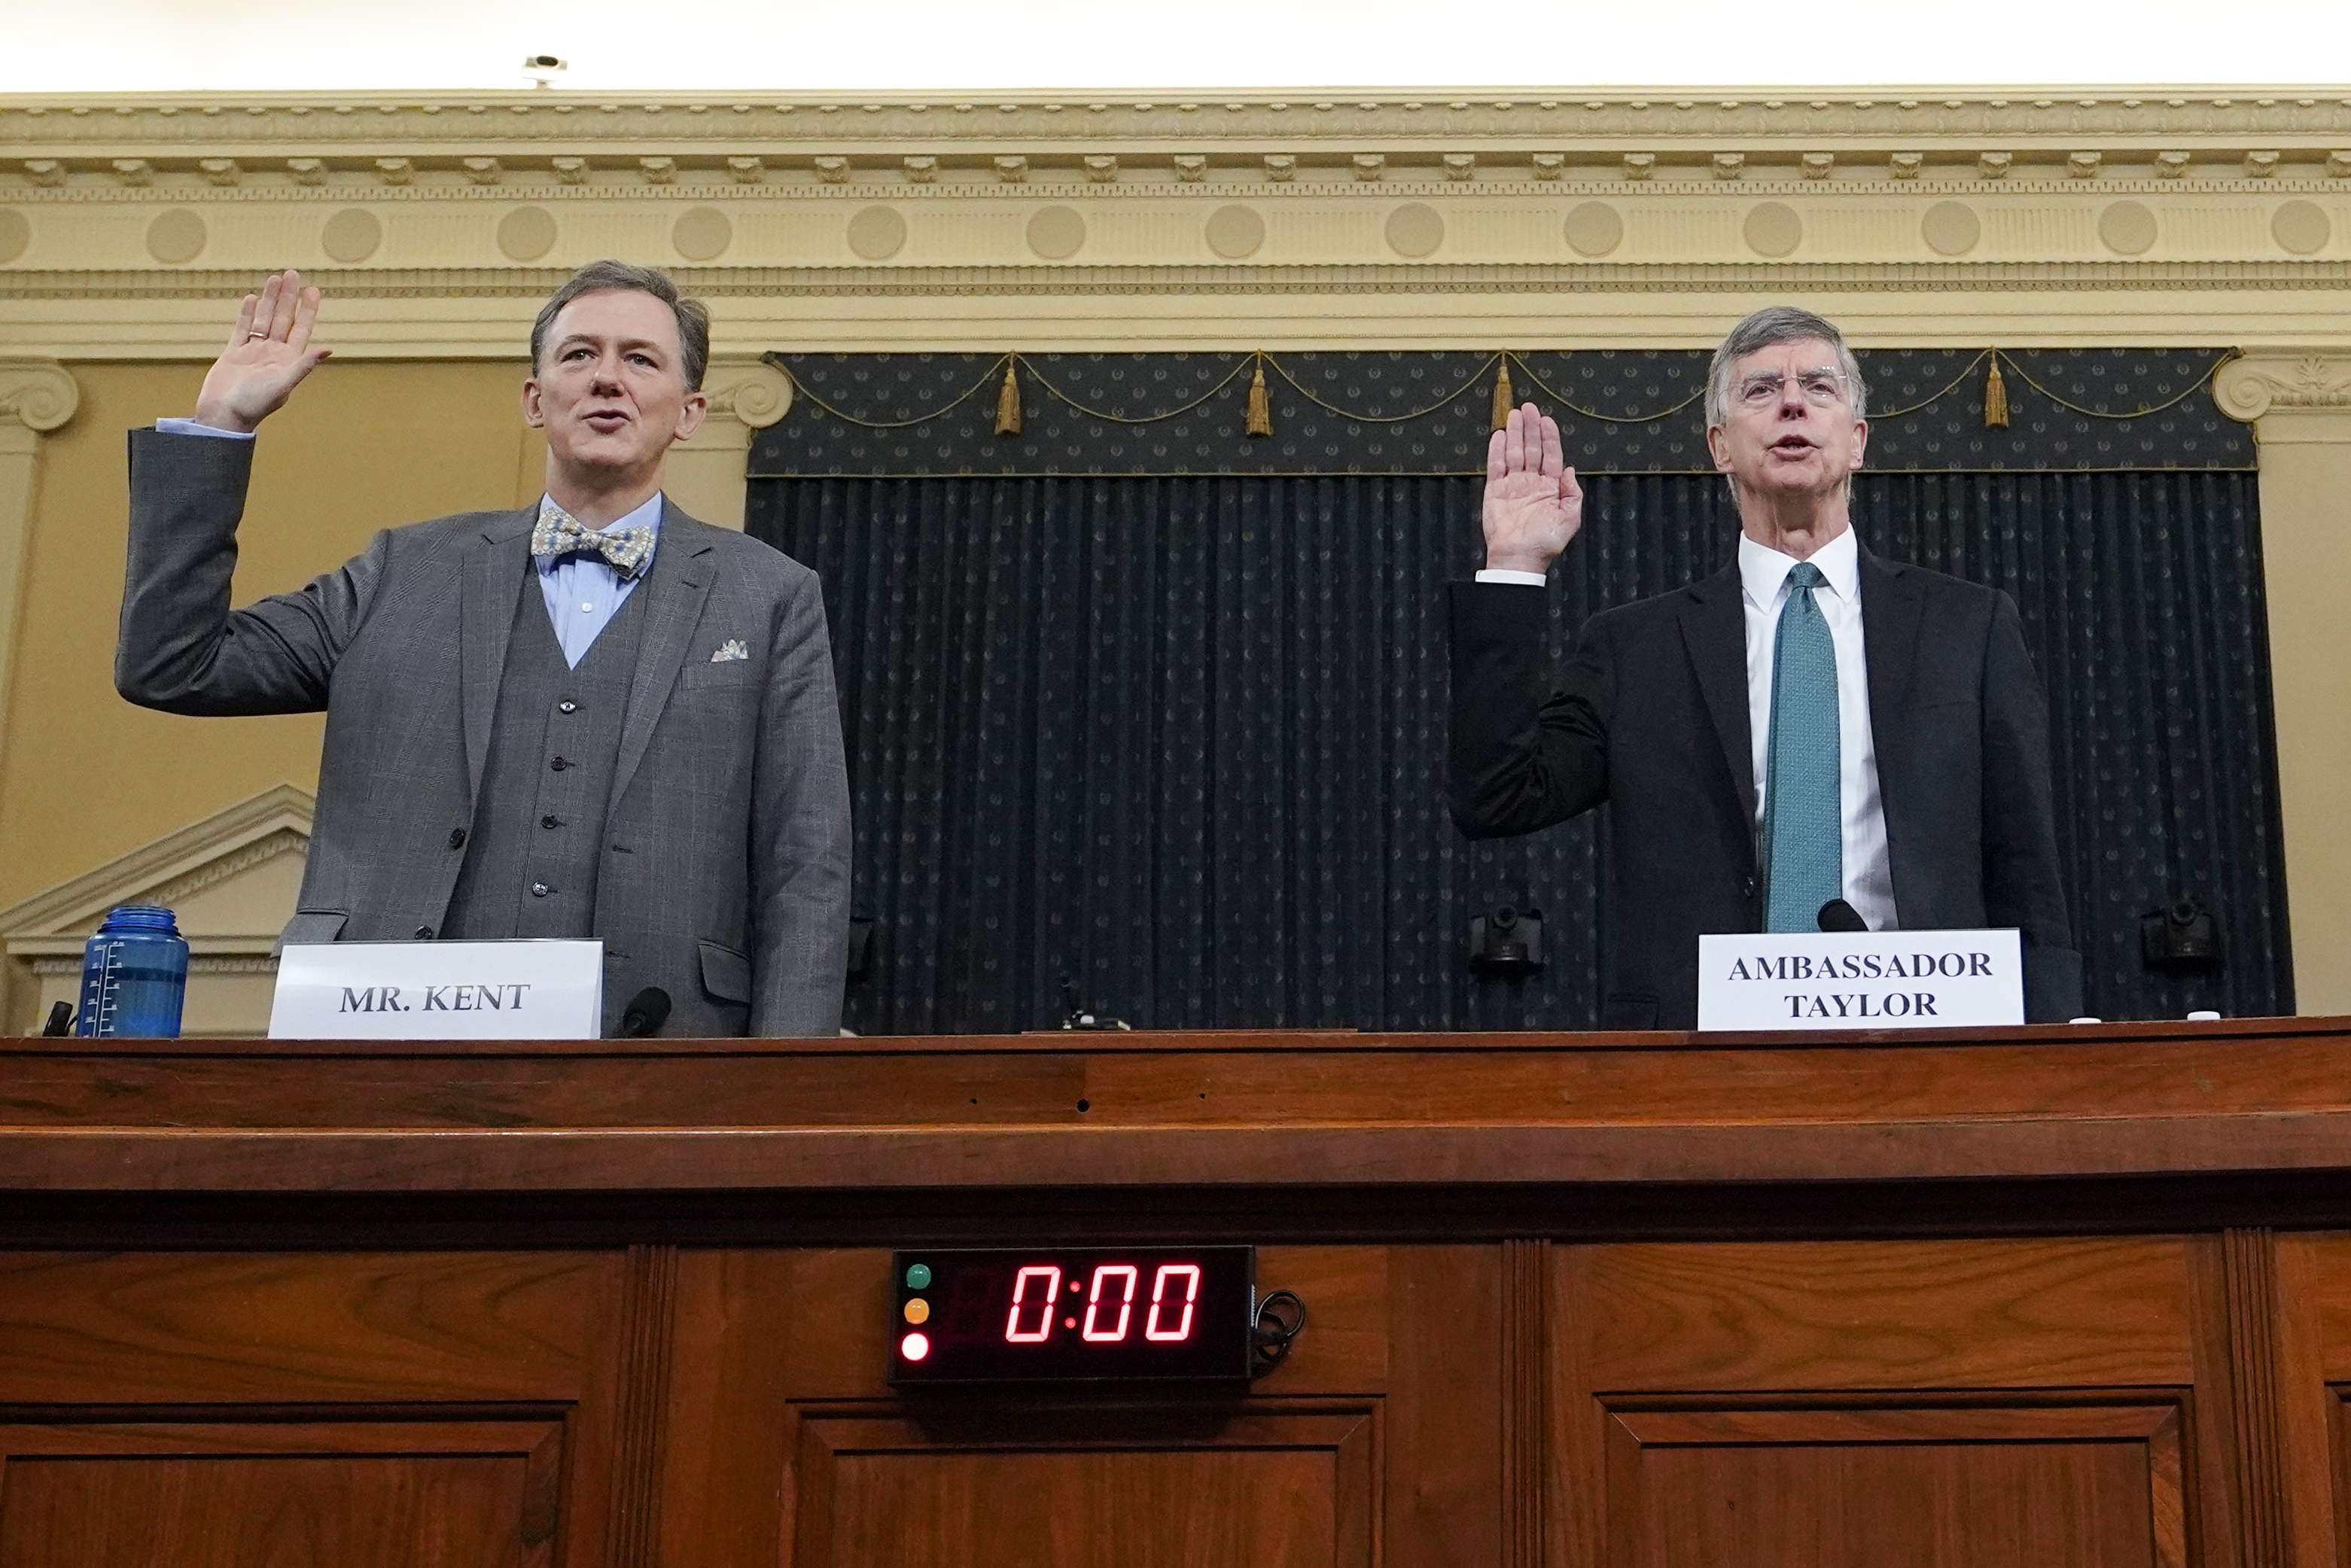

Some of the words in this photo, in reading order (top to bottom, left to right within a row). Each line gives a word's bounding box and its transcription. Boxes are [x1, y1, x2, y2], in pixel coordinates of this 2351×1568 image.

[1728, 952, 1994, 981] AMBASSADOR
[338, 987, 411, 1012] MR.
[422, 983, 531, 1011] KENT
[1784, 992, 1939, 1018] TAYLOR
[1004, 1264, 1201, 1344] 0:00
